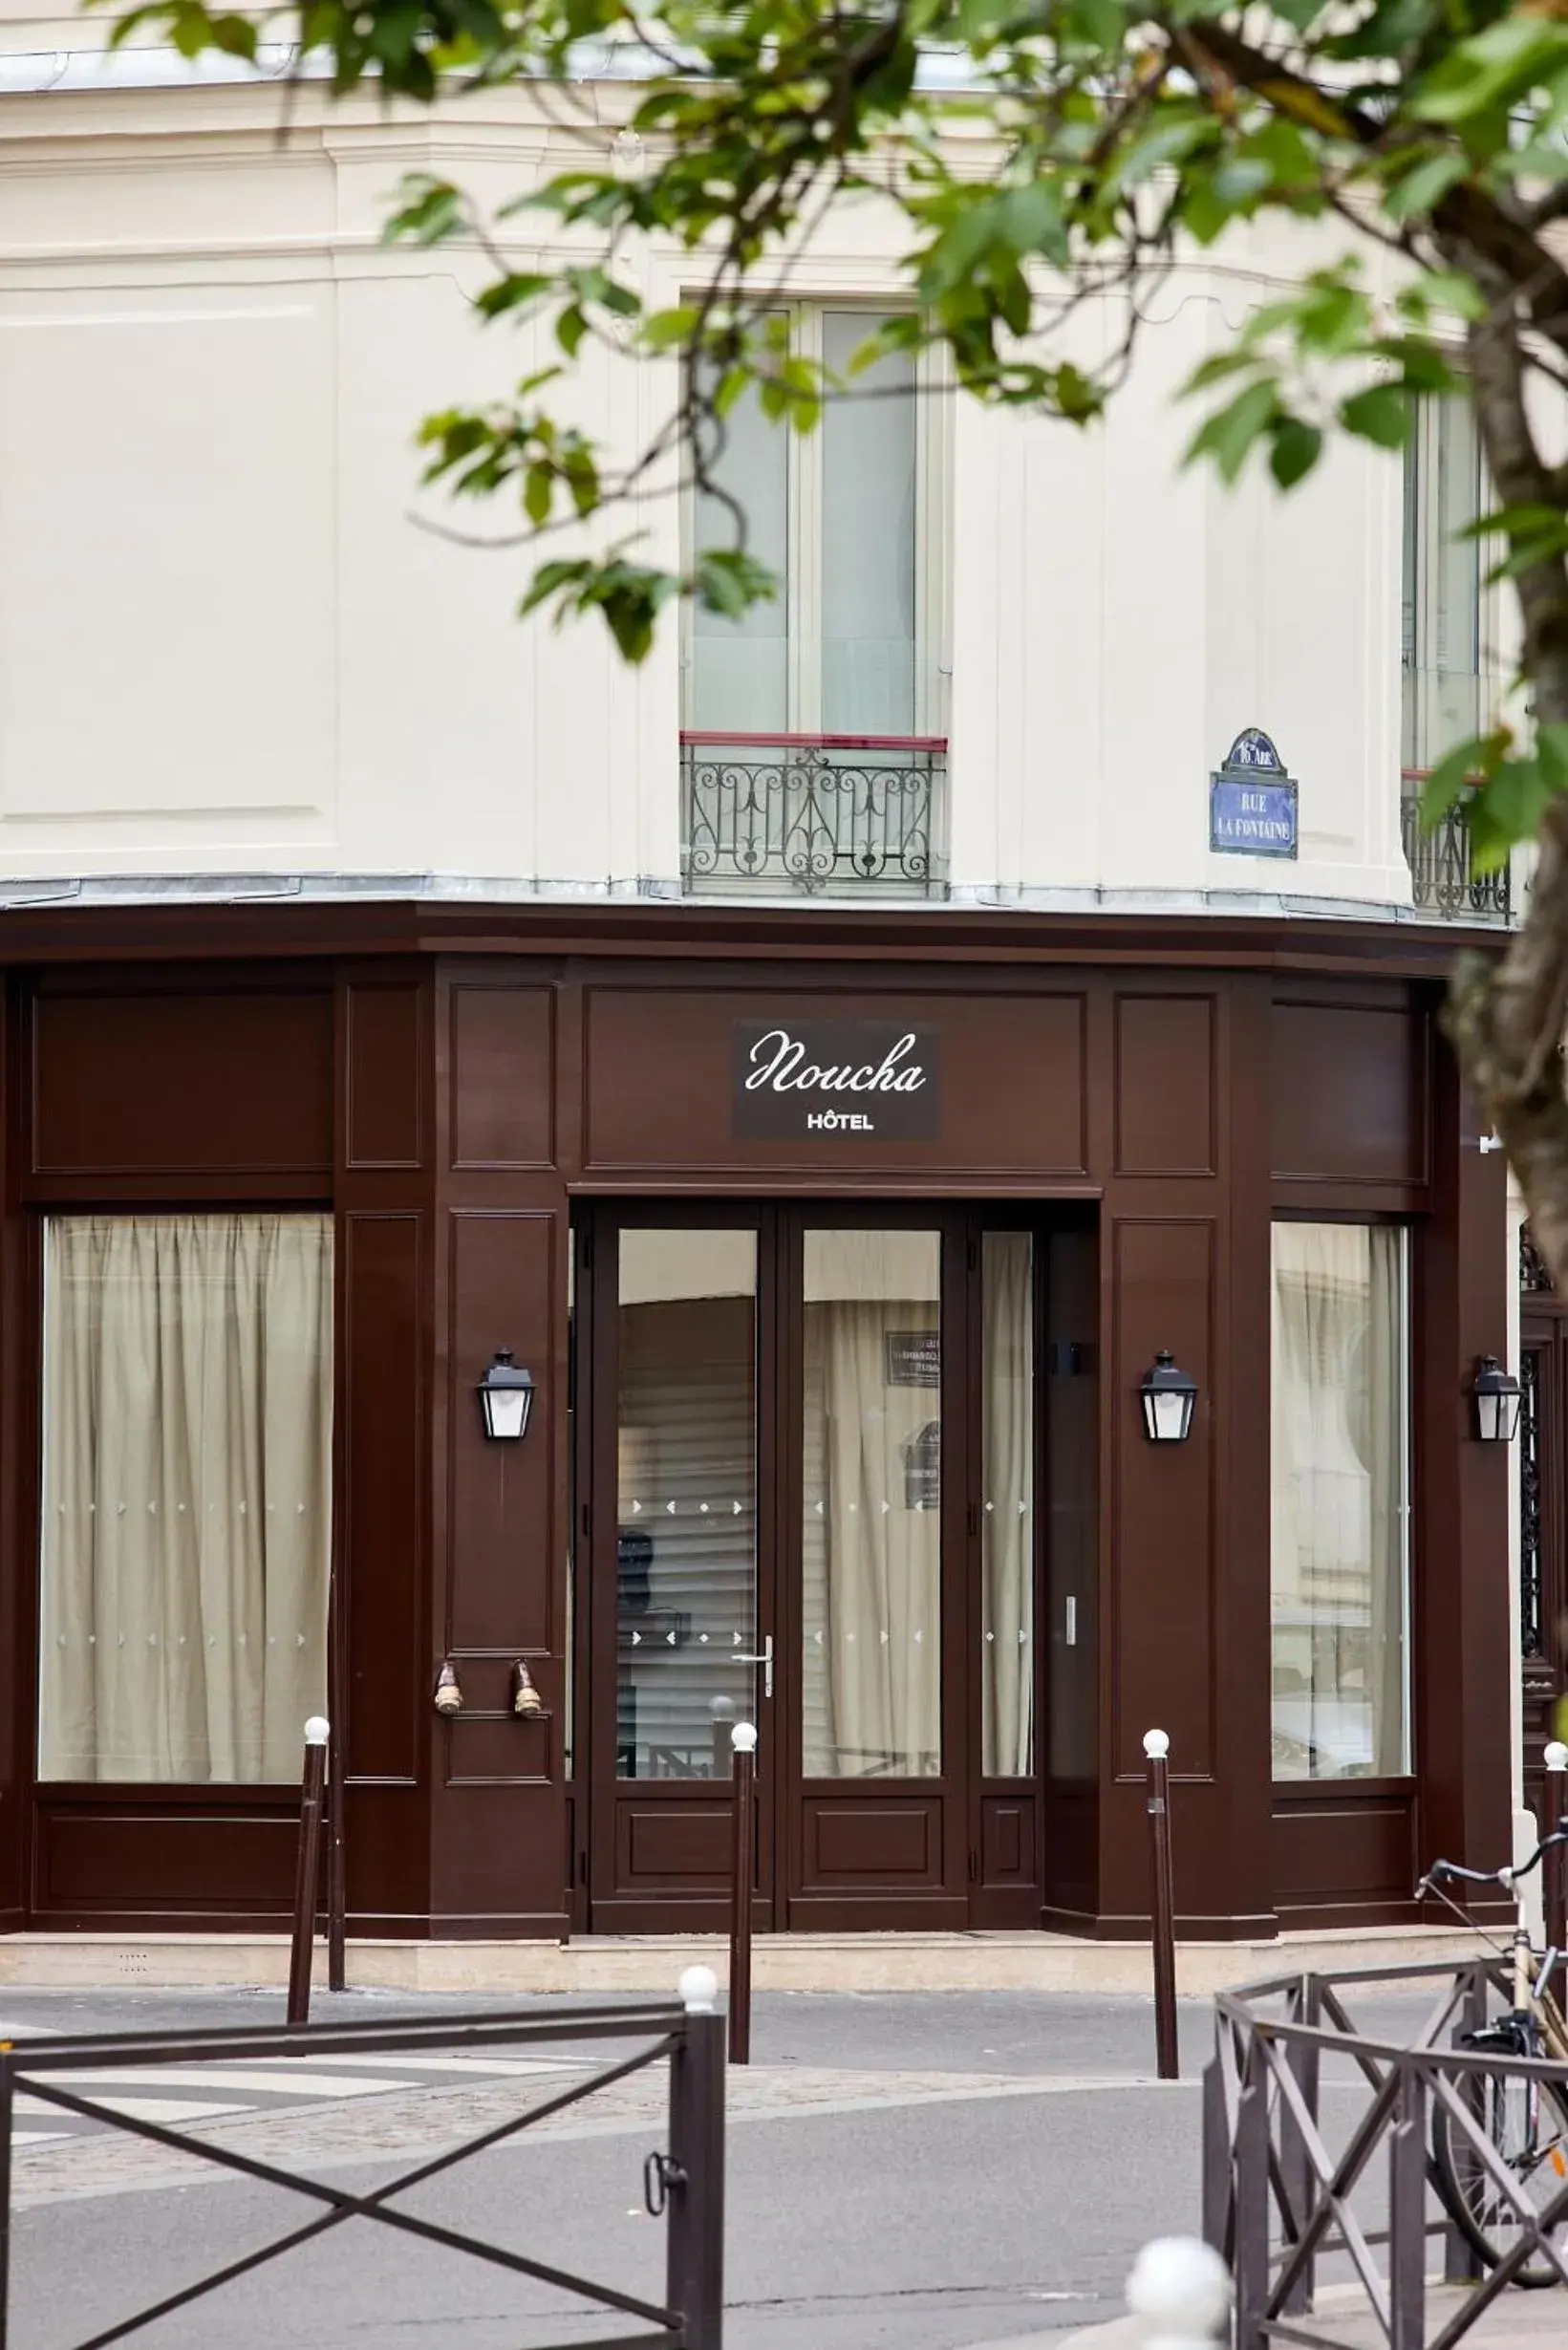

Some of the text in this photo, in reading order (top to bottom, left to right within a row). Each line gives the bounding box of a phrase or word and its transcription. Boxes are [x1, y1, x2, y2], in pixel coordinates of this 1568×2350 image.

[1241, 793, 1267, 812] RUE
[1217, 817, 1290, 841] LA FONTAINE
[744, 1030, 927, 1091] Noucha
[806, 1109, 874, 1131] HÔTEL
